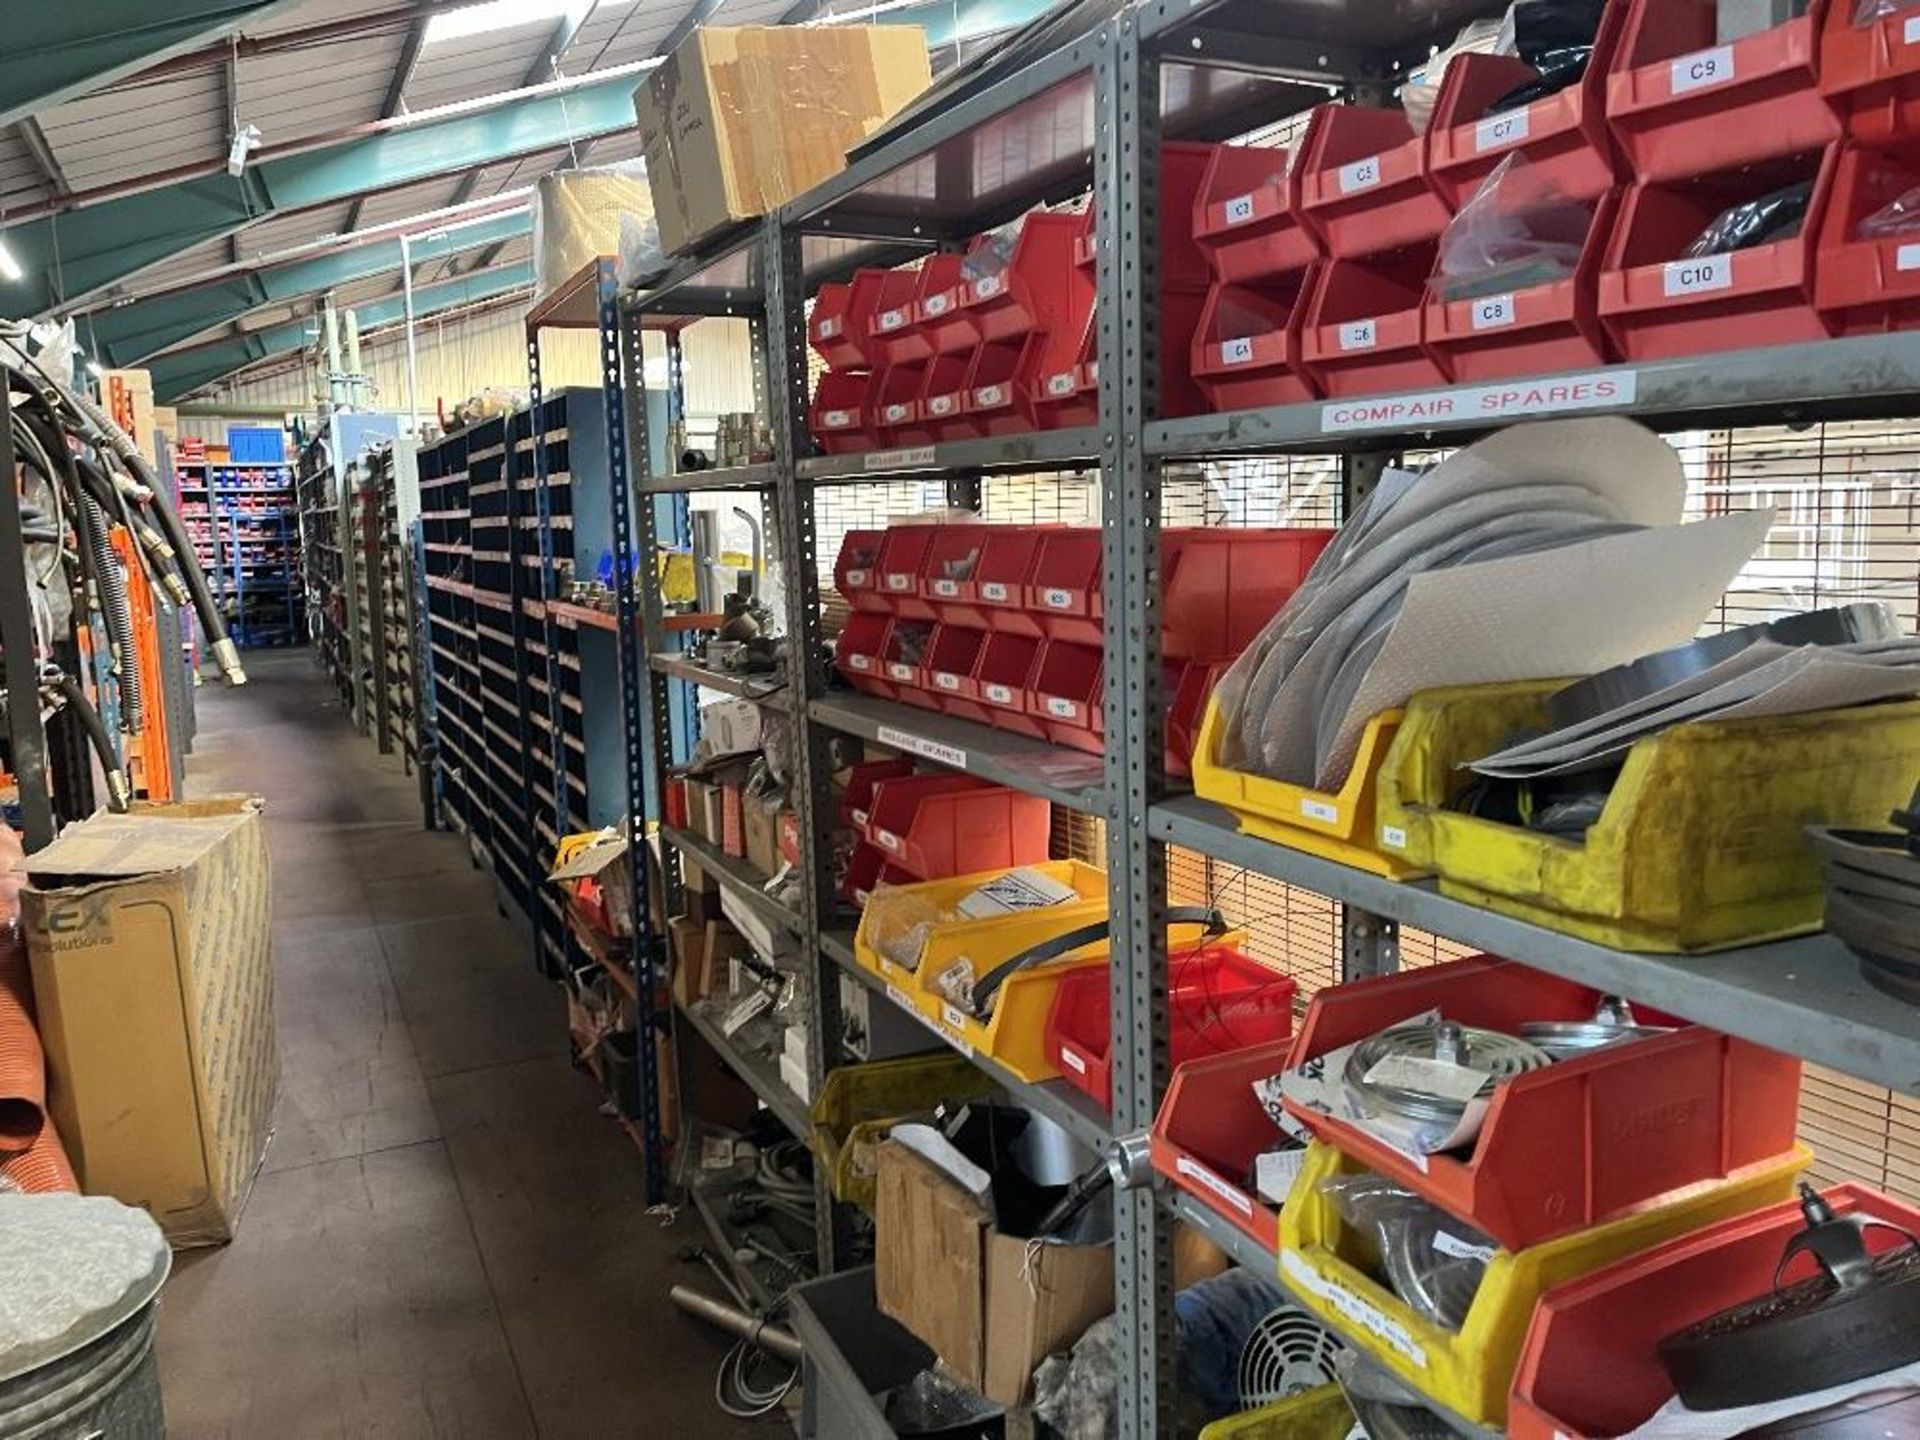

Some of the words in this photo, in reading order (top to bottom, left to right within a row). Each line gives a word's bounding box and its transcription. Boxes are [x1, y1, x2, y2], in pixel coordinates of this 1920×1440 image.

[1690, 61, 1716, 80] C9
[1493, 120, 1512, 137] C7
[1680, 266, 1713, 286] C10
[1483, 305, 1502, 319] C8
[1334, 399, 1454, 425] COMPAIR
[1481, 381, 1616, 410] SPARES
